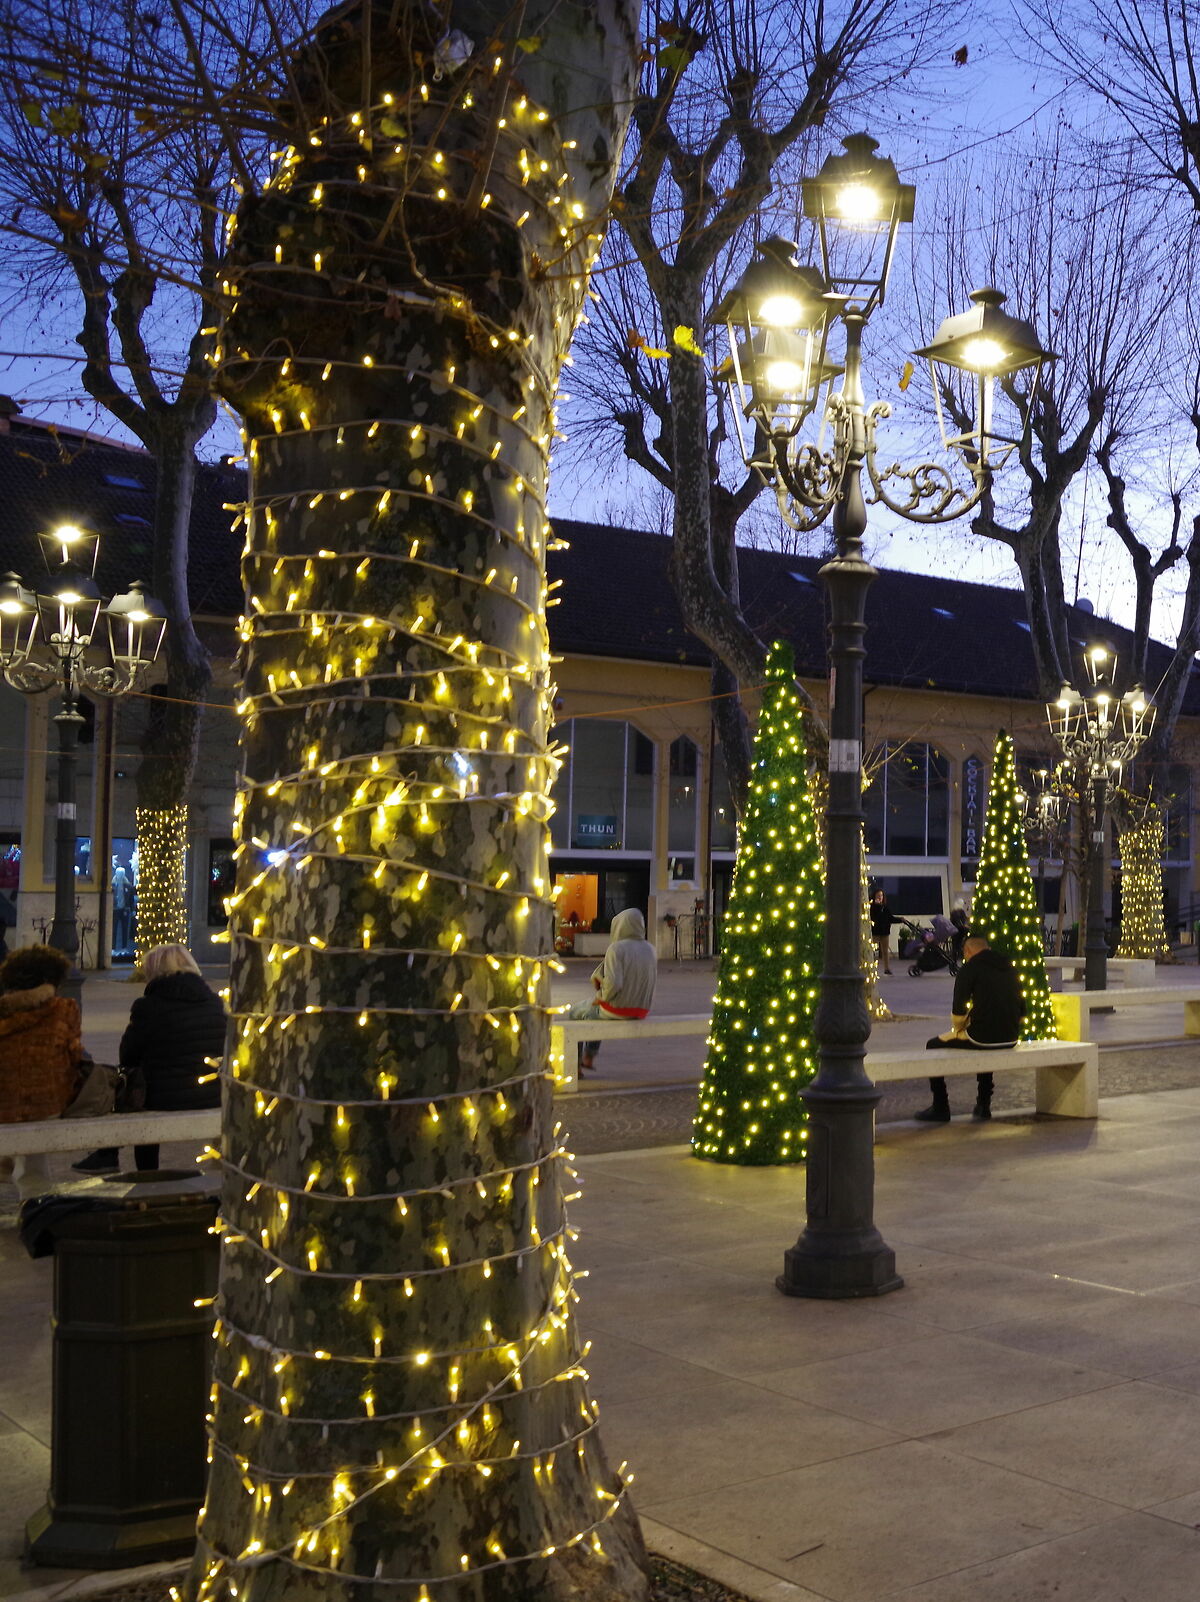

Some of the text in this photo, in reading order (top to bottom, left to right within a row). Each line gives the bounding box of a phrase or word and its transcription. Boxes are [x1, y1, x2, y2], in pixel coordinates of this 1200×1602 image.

[580, 824, 614, 833] THUN
[966, 760, 978, 854] COCKTAIL BAR
